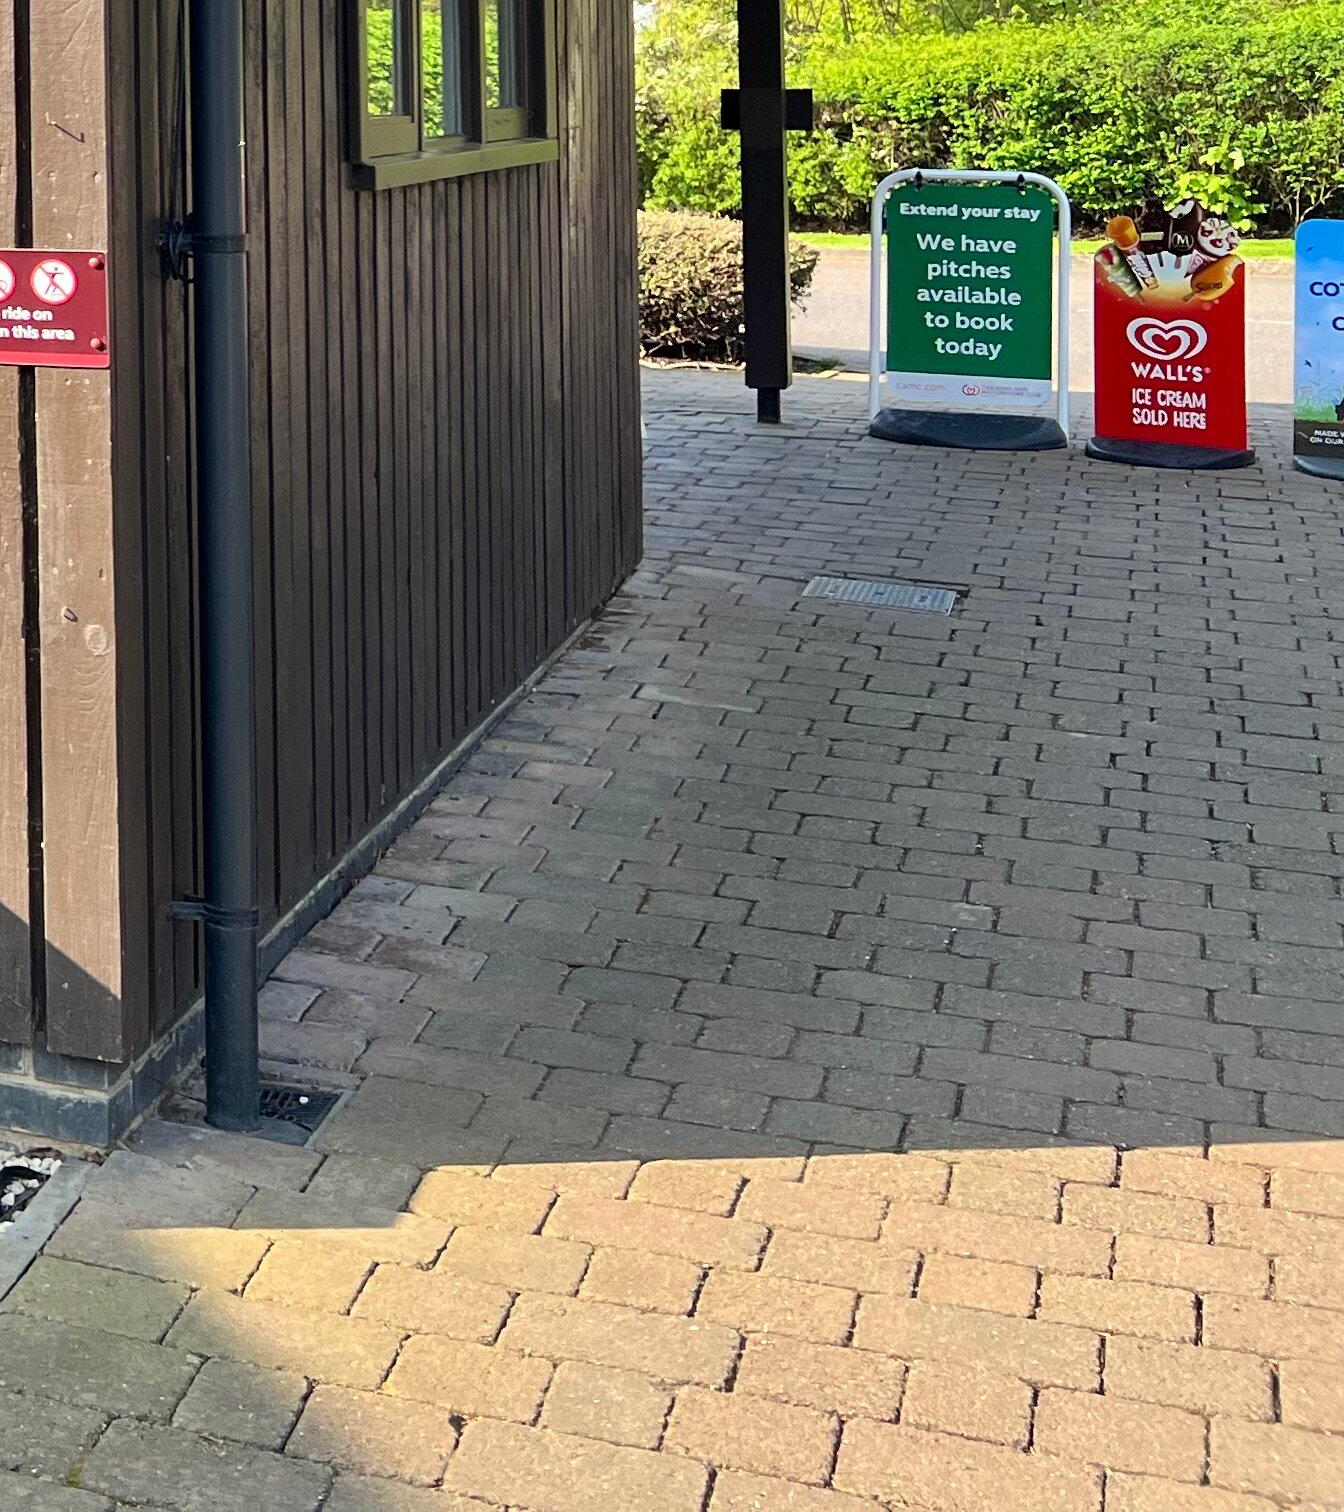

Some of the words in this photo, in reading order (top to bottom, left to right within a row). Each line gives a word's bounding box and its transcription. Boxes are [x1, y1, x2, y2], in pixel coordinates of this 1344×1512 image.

[899, 202, 958, 217] Extend
[961, 206, 1001, 220] your
[1003, 207, 1041, 222] stay
[916, 233, 955, 251] We
[961, 234, 1017, 254] have
[927, 259, 1012, 280] pitches
[916, 285, 1022, 306] available
[1, 305, 31, 321] ride
[32, 309, 54, 322] on
[924, 311, 950, 328] to
[955, 312, 1014, 331] book
[11, 324, 40, 340] this
[40, 328, 76, 341] area
[934, 338, 1003, 361] today
[1130, 361, 1204, 382] WALL'S
[1131, 388, 1152, 406] ICE
[1156, 389, 1206, 410] CREAM
[1132, 407, 1169, 426] SOLD
[1173, 410, 1207, 429] HERE
